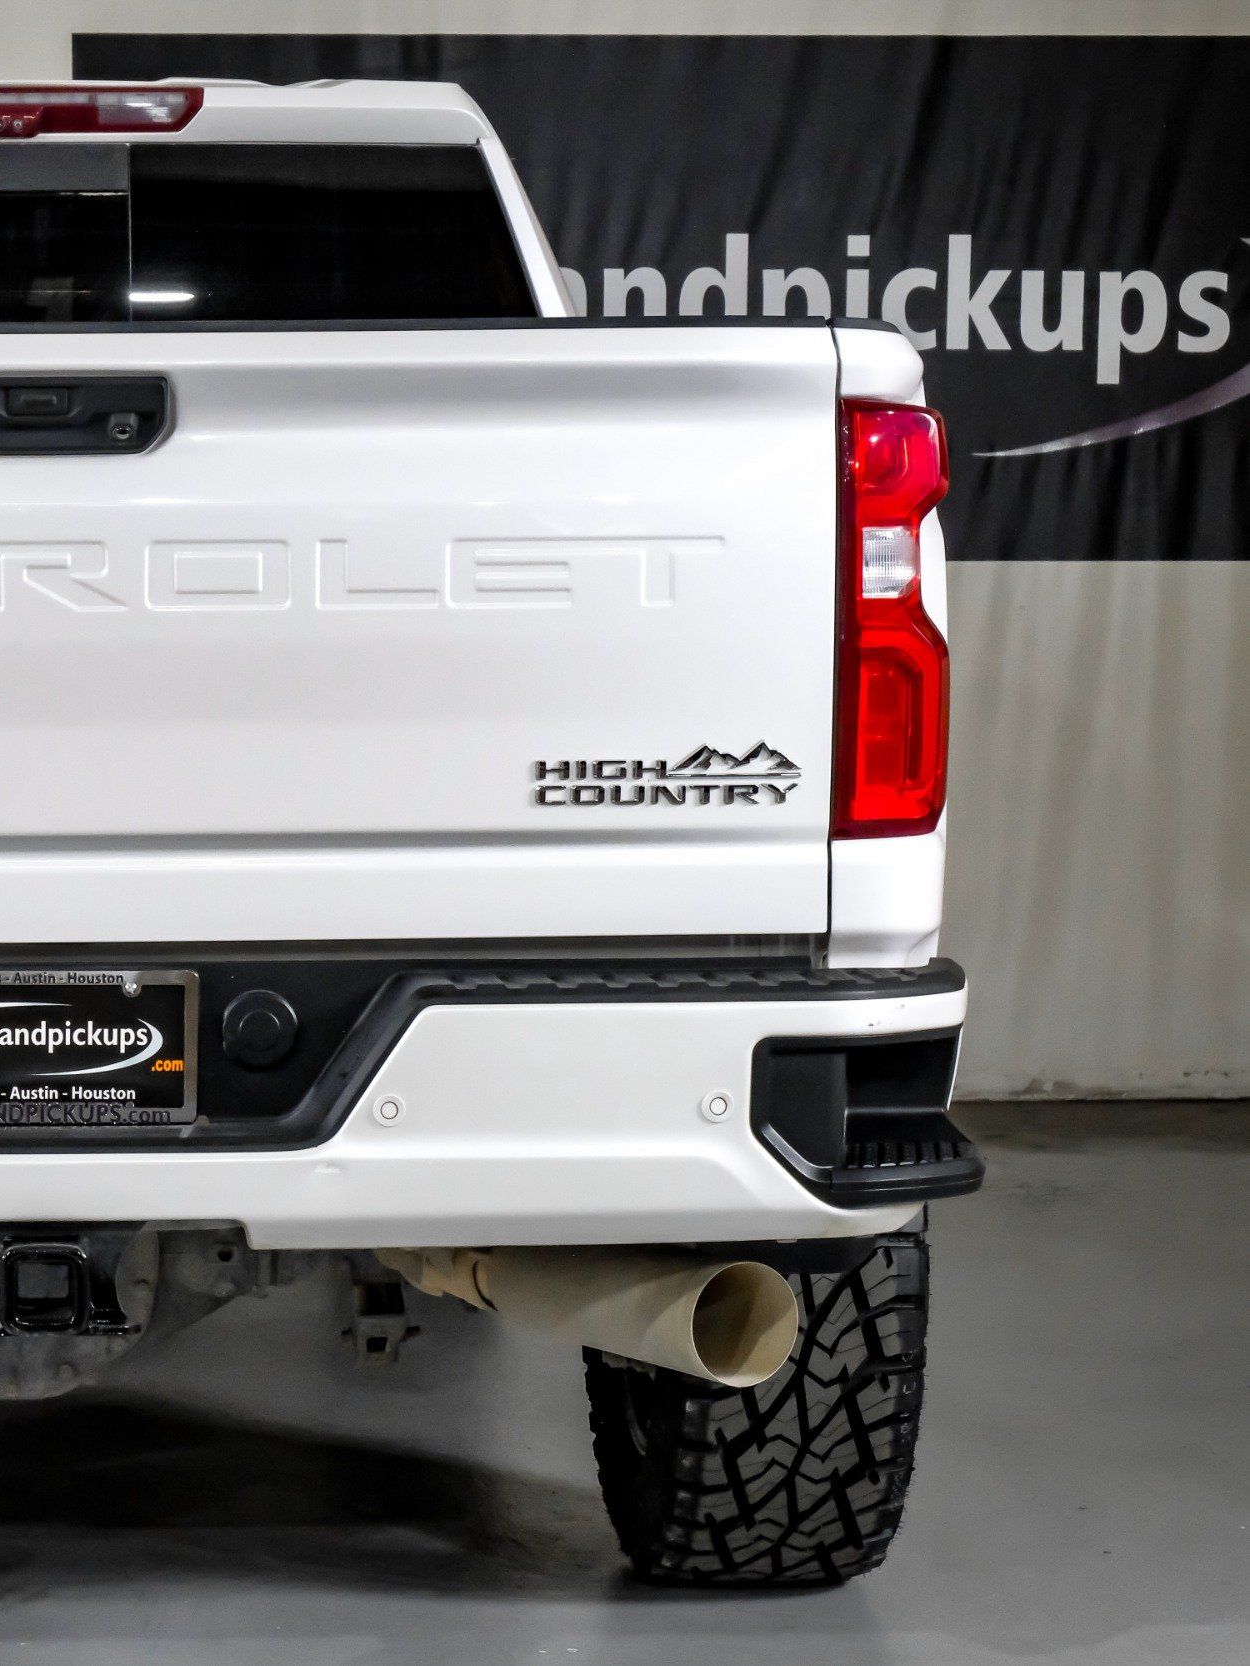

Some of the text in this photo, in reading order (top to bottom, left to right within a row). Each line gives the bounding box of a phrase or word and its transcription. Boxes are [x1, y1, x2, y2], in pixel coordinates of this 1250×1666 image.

[534, 760, 668, 781] HIGH
[534, 783, 799, 806] COUNTRY
[13, 972, 56, 984] Austin
[67, 972, 125, 984] Houston
[151, 1059, 184, 1072] .com
[9, 1085, 59, 1100] Austin
[71, 1086, 136, 1100] Houston
